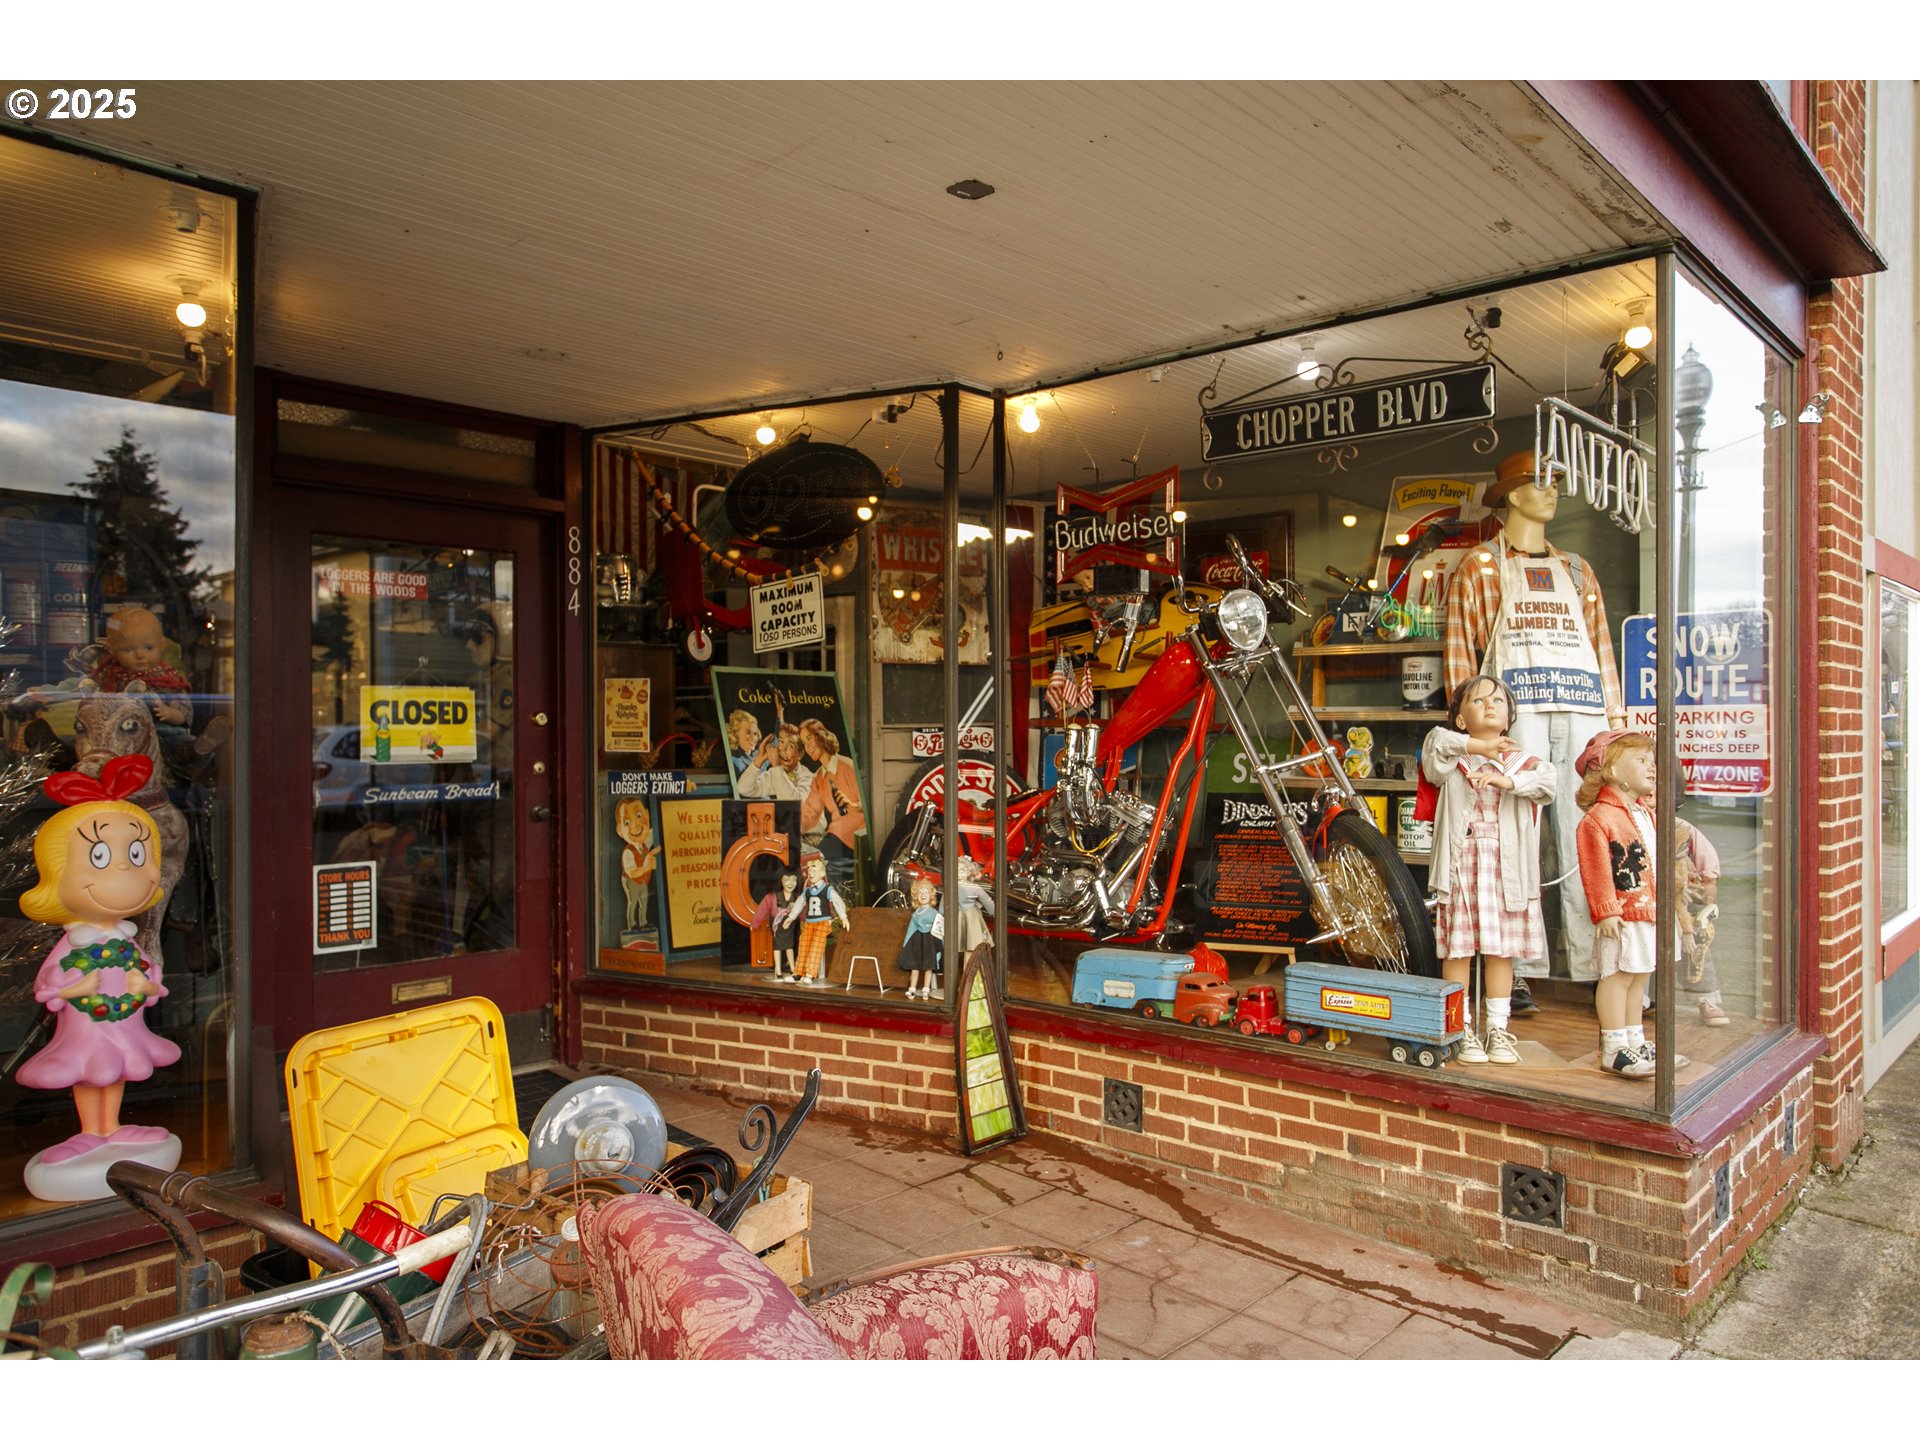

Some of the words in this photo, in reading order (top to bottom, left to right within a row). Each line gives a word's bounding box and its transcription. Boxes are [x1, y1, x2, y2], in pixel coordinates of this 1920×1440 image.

[1237, 396, 1355, 450] CHOPPER
[1377, 380, 1448, 428] BLVD
[1401, 486, 1438, 503] Exciting
[320, 567, 370, 582] LOGGERS
[373, 571, 395, 584] ARE
[397, 573, 427, 586] GOOD
[567, 526, 581, 616] 884
[332, 581, 344, 593] IN
[349, 582, 371, 594] THE
[375, 584, 416, 597] WOODS
[759, 581, 813, 603] MAXIMUM
[771, 598, 803, 616] ROOM
[1514, 601, 1570, 615] KENOSHA
[760, 610, 815, 632] CAPACITY
[1507, 617, 1558, 630] LUMBER
[1562, 618, 1579, 632] CO.
[783, 624, 818, 640] PERSONS
[1549, 640, 1580, 648] WISCONSIN
[1511, 670, 1594, 688] Johns-Manville
[738, 688, 772, 703] Coke
[788, 690, 835, 709] belongs
[1513, 686, 1555, 702] uilding
[1556, 685, 1602, 703] Materials
[369, 699, 468, 725] CLOSED
[1686, 730, 1728, 739] SNOW
[1734, 730, 1747, 739] IS
[1679, 743, 1723, 753] INCHES
[1728, 743, 1760, 753] DEEP
[622, 772, 647, 781] DON'T
[650, 772, 673, 781] MAKE
[1683, 765, 1711, 781] WAY
[1713, 765, 1760, 782] ZONE
[363, 787, 438, 804] Sunbeam
[444, 783, 496, 800] Bread
[611, 781, 649, 794] LOGGERS
[652, 780, 686, 794] EXTINCT
[698, 813, 721, 824] SELL
[679, 831, 721, 842] QUALITY
[672, 845, 721, 858] MERCHANDI
[681, 862, 721, 873] REASONA
[319, 872, 343, 884] STORE
[344, 869, 370, 881] HOURS
[692, 899, 714, 914] Come
[693, 914, 709, 925] look
[319, 931, 350, 943] THANK
[352, 928, 371, 939] YOU
